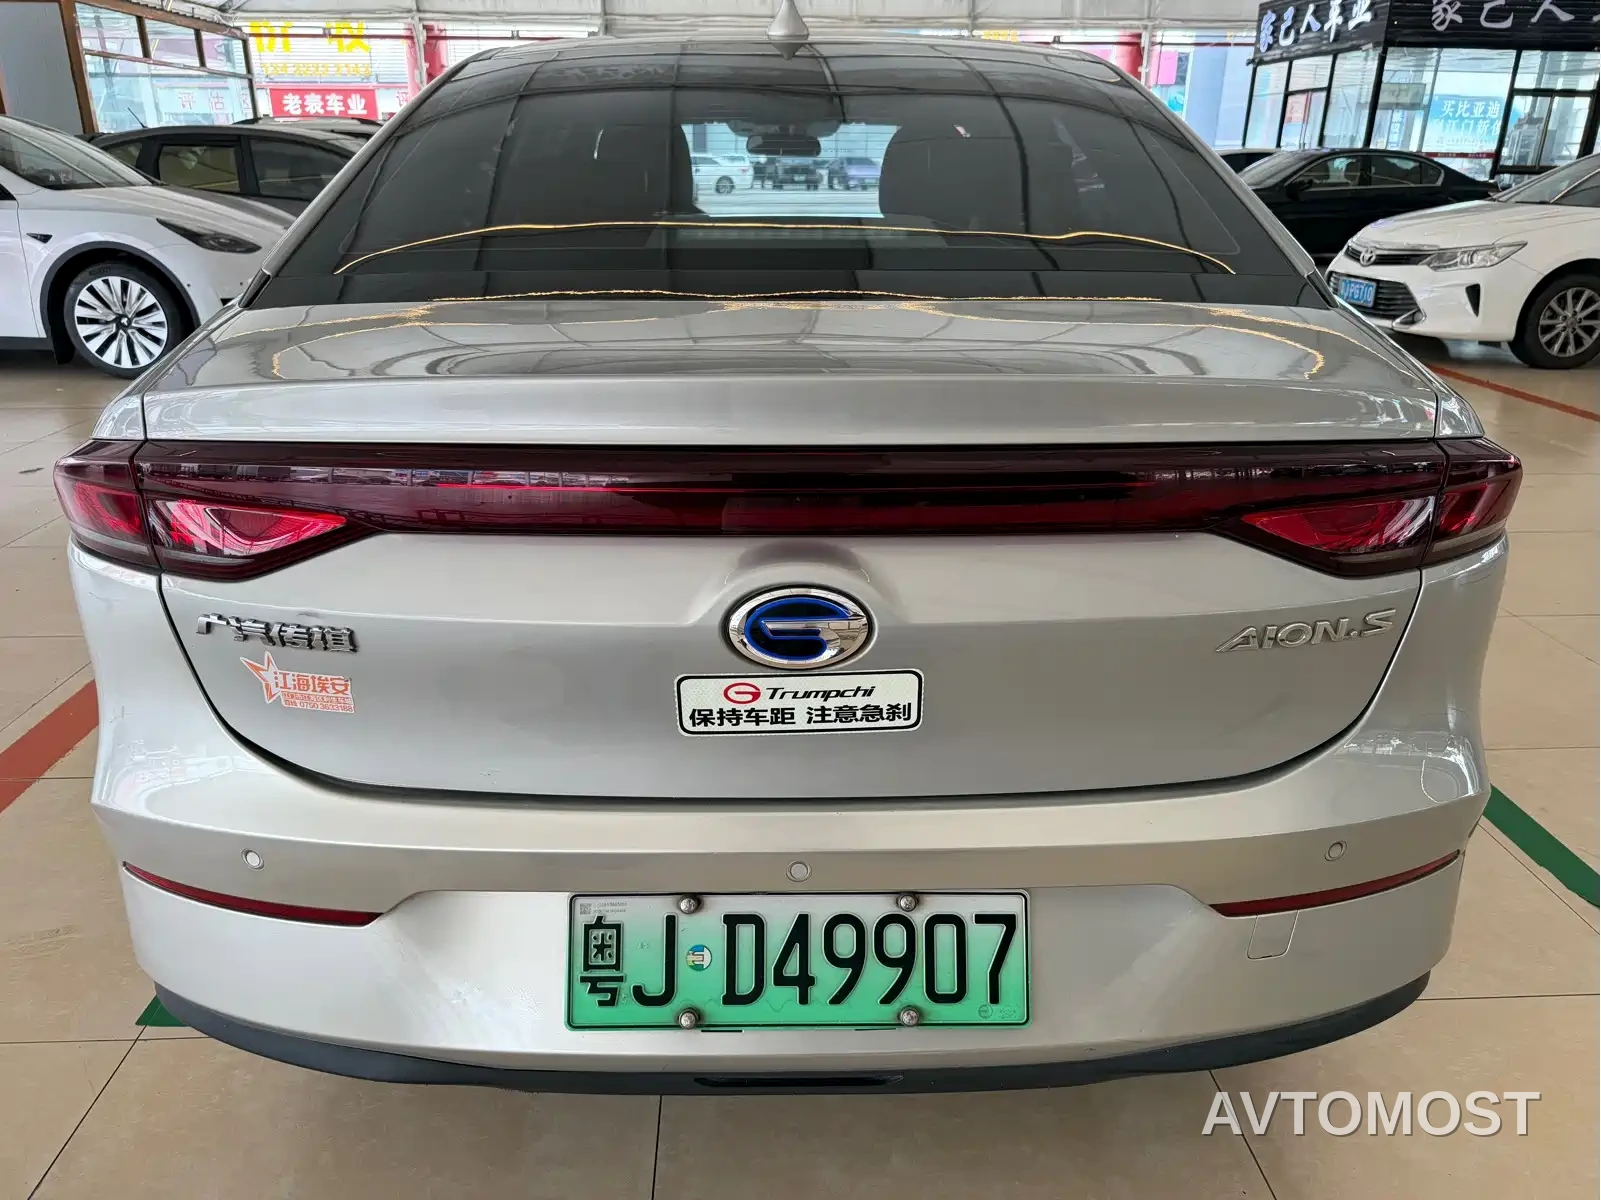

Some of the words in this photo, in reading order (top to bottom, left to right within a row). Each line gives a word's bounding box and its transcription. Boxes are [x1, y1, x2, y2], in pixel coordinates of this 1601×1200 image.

[1440, 99, 1501, 119] 买比亚迪
[1215, 607, 1397, 653] AION.S
[273, 671, 351, 695] 江海埃安
[766, 686, 876, 702] Trumpchi
[689, 707, 796, 727] 保持车距
[806, 702, 912, 725] 注意急刹
